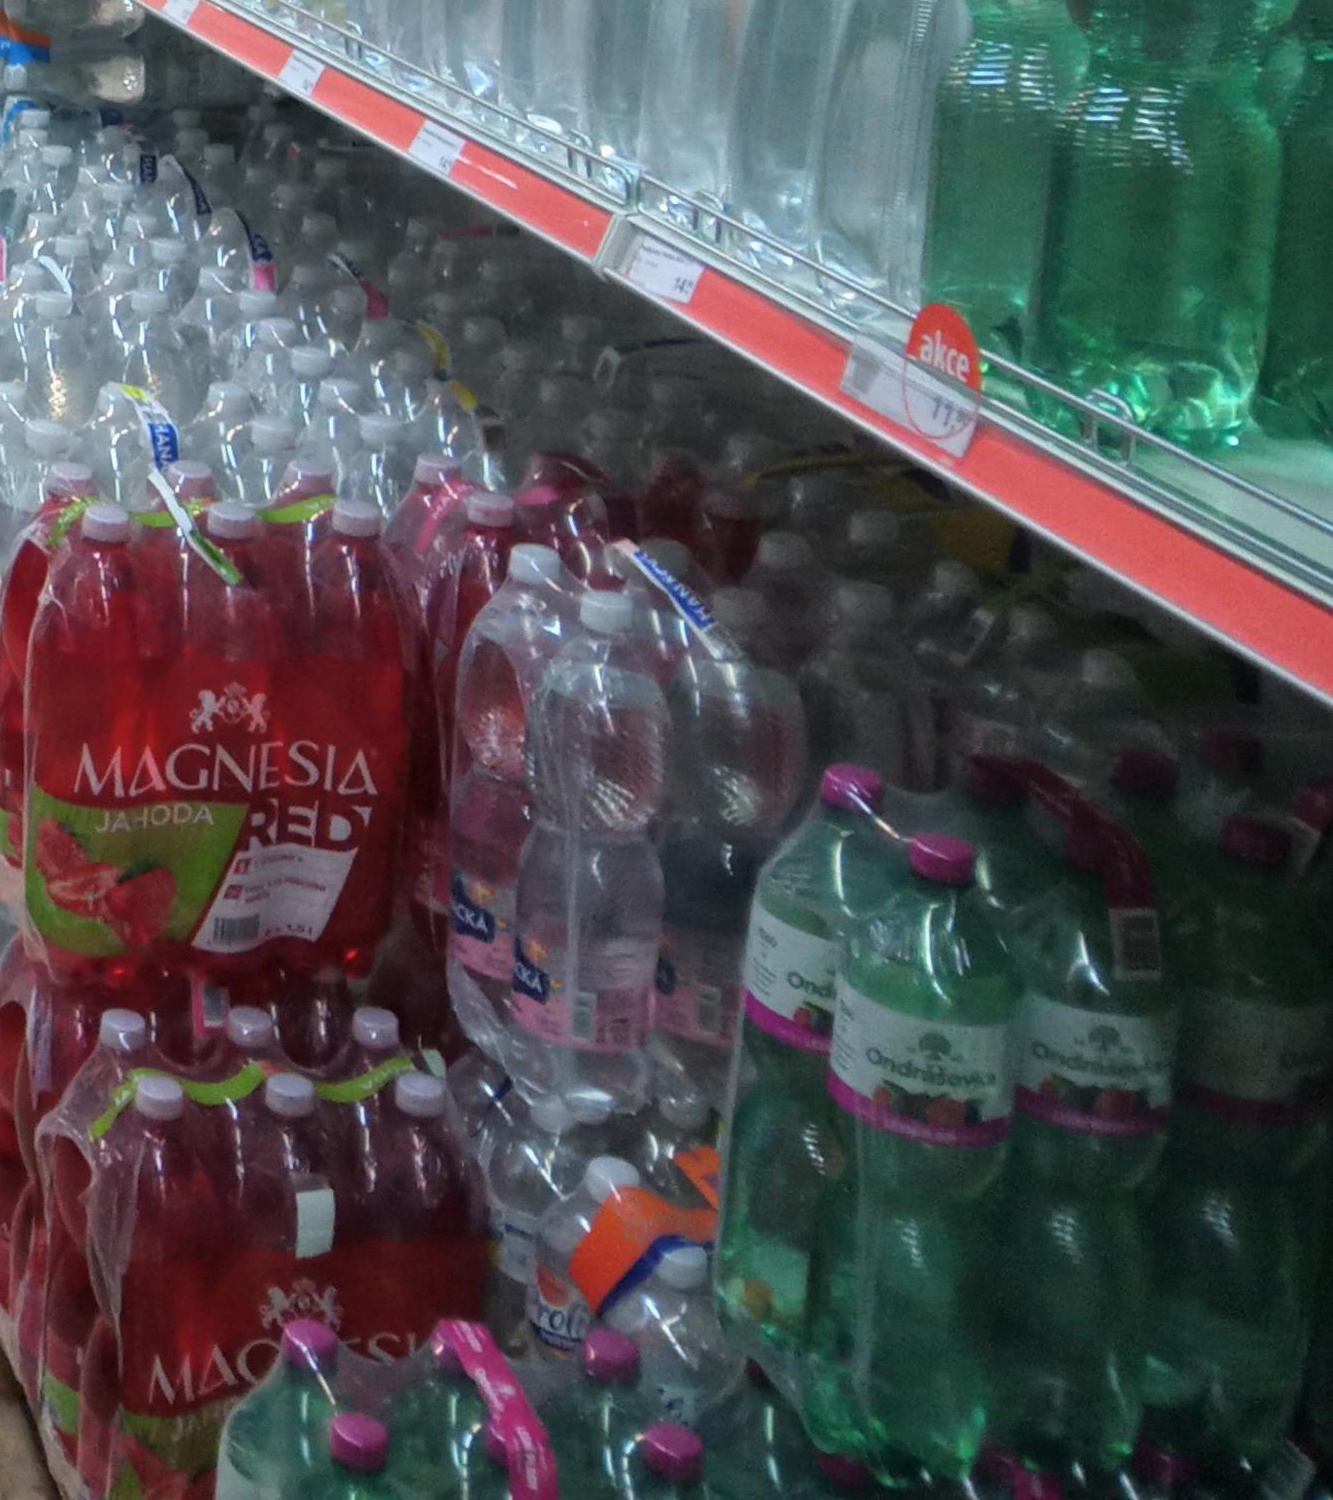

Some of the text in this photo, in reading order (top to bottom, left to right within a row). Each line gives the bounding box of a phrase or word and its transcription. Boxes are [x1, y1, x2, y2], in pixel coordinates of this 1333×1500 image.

[917, 329, 972, 384] akce
[73, 738, 379, 800] MAGNESIA
[94, 801, 215, 834] JAHODA
[248, 797, 374, 852] RED
